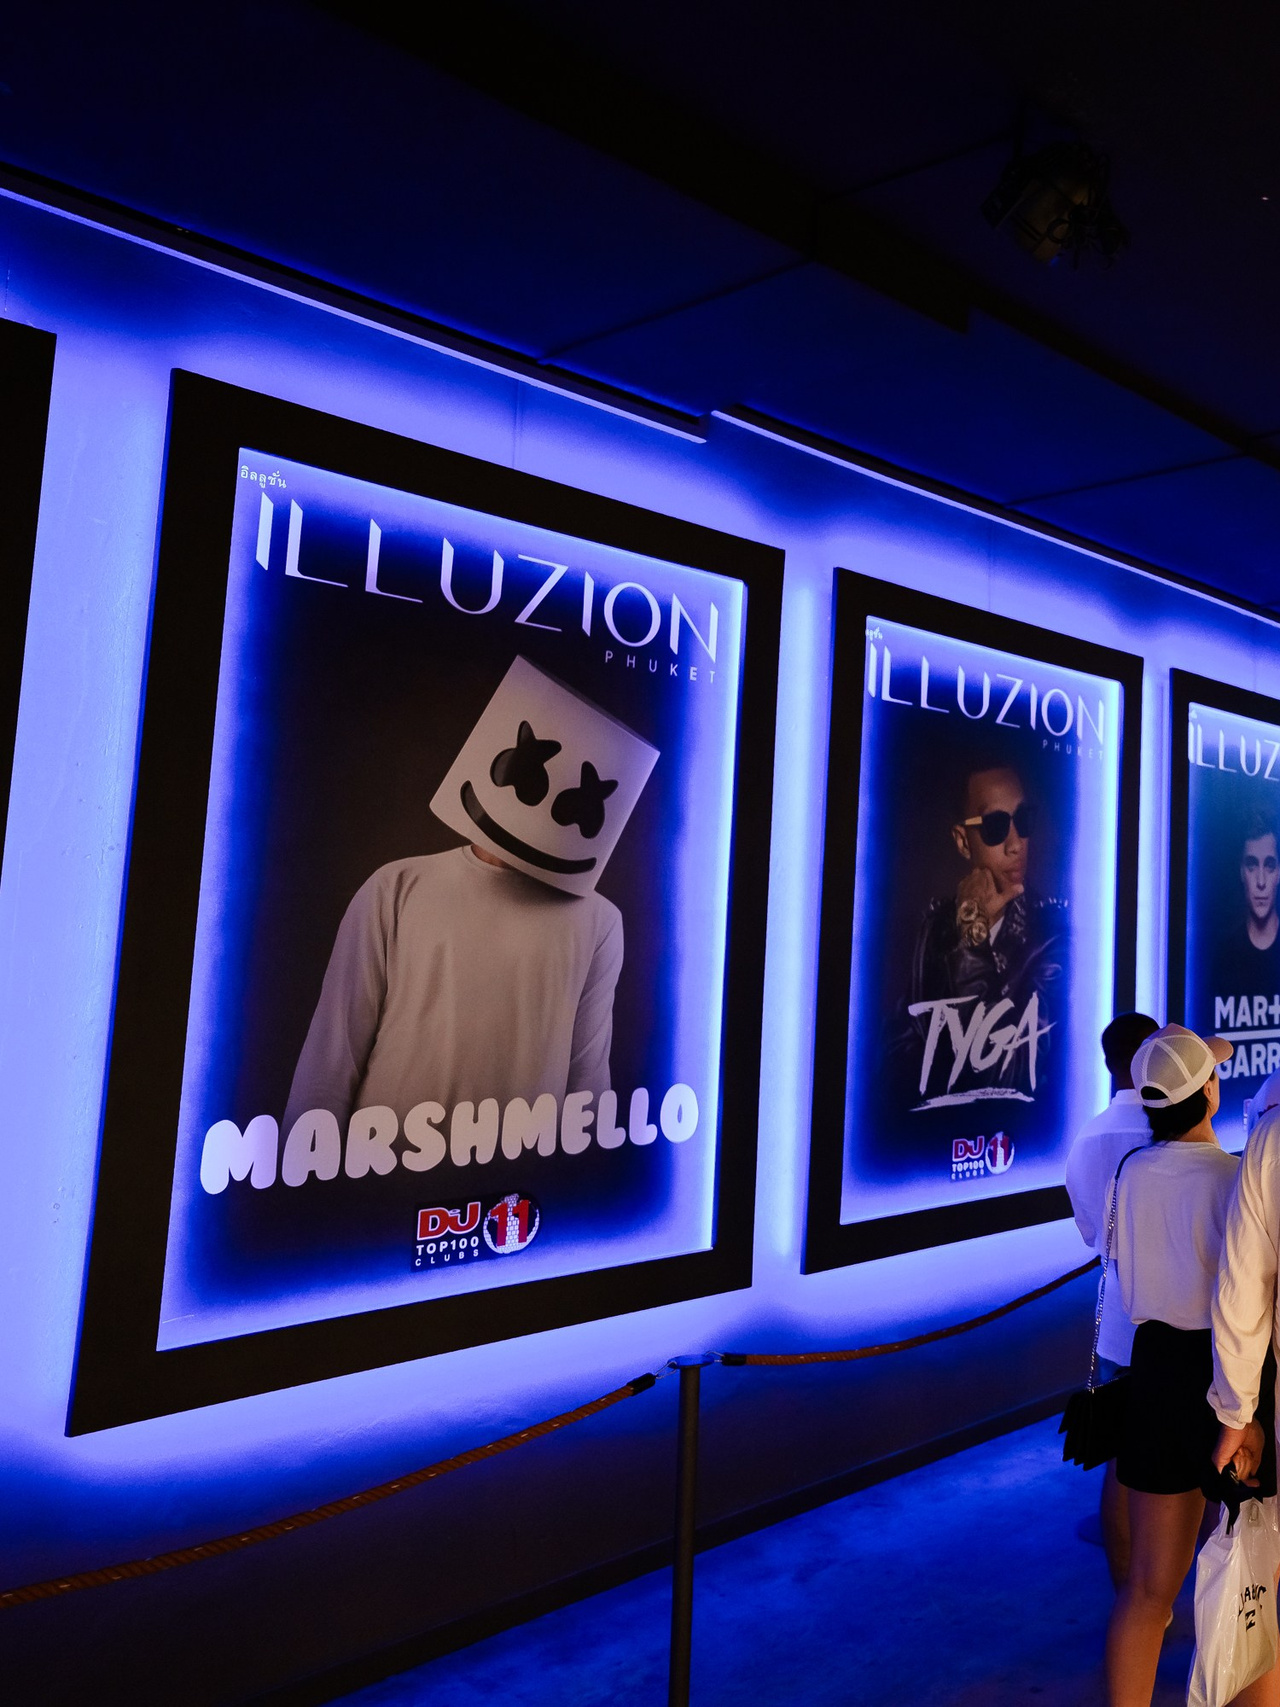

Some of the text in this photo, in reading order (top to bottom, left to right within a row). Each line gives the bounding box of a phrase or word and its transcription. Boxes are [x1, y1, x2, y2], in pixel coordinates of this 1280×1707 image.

[256, 492, 719, 663] ILLUZION
[605, 650, 715, 683] PHUKET
[868, 643, 1104, 745] ILLUZION
[908, 991, 1057, 1096] TYGA
[200, 1083, 699, 1195] MARSHMELLO
[416, 1236, 479, 1256] TOP100
[417, 1201, 481, 1241] DJ
[415, 1249, 479, 1266] CLUBS
